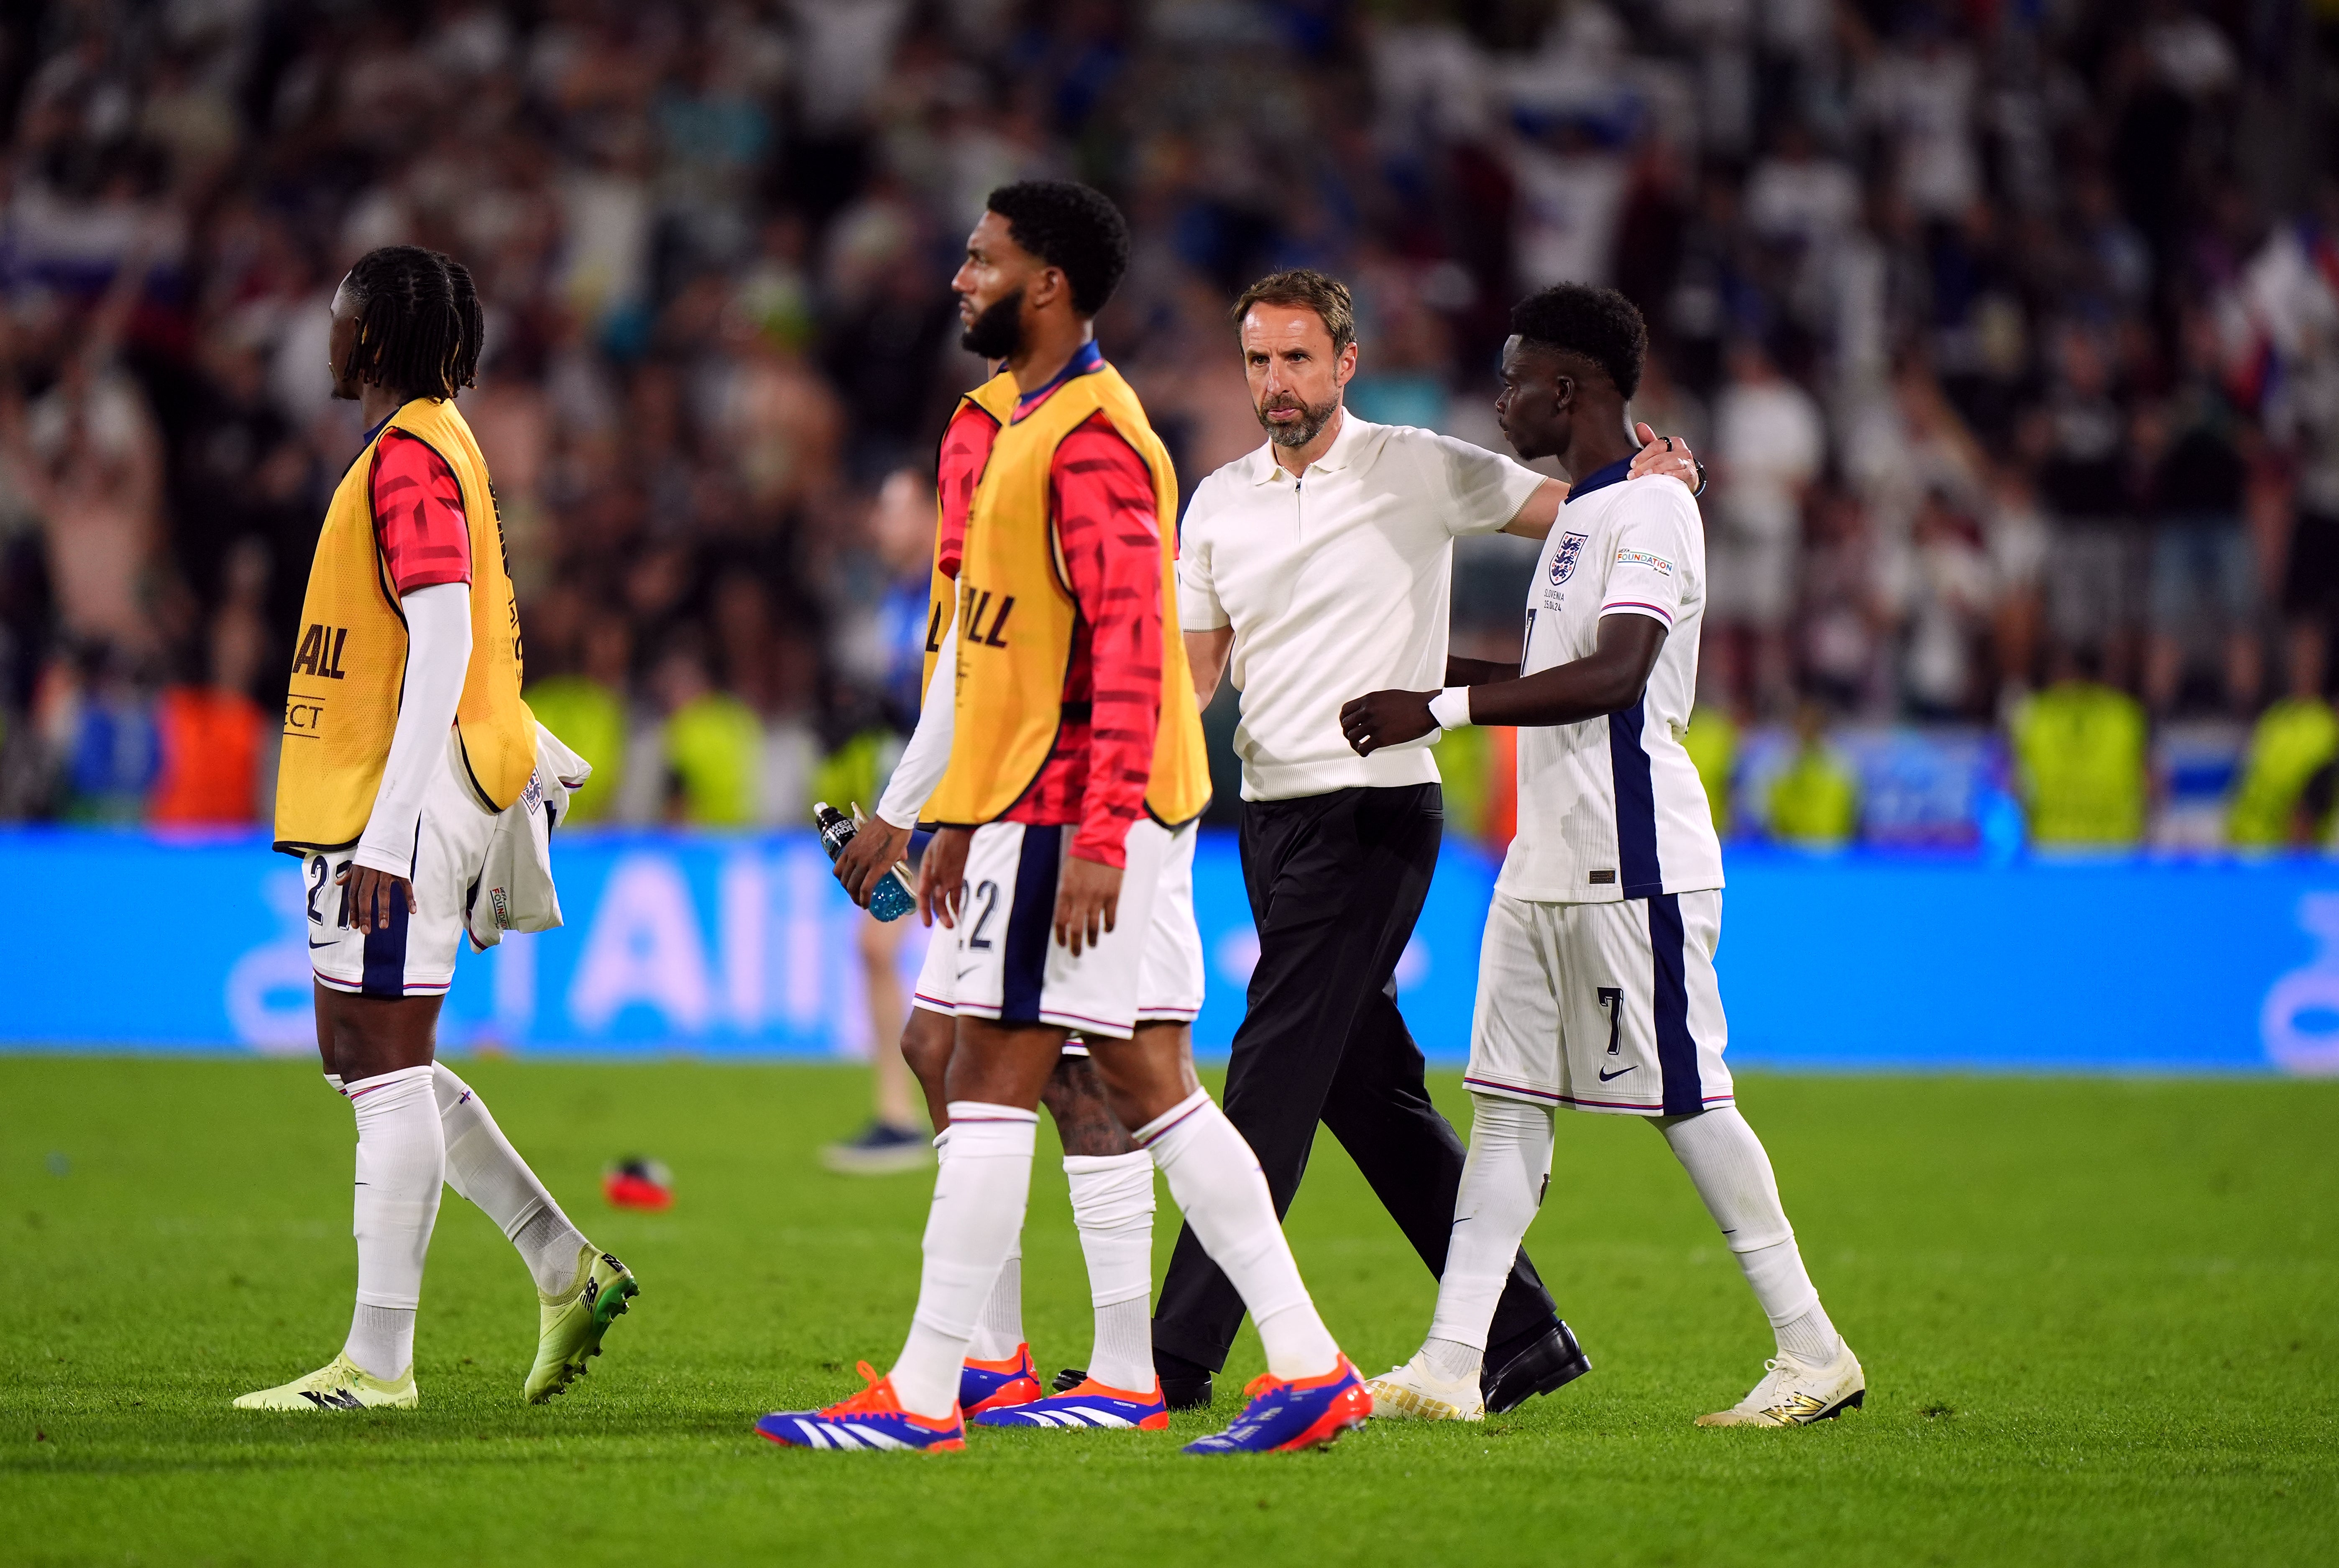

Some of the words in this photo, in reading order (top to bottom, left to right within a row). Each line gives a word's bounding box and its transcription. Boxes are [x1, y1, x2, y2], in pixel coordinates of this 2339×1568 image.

[1617, 553, 1672, 572] FOUNDATION
[1544, 588, 1564, 601] SLOVENIA
[822, 819, 851, 844] POWER
[1597, 987, 1623, 1055] 7
